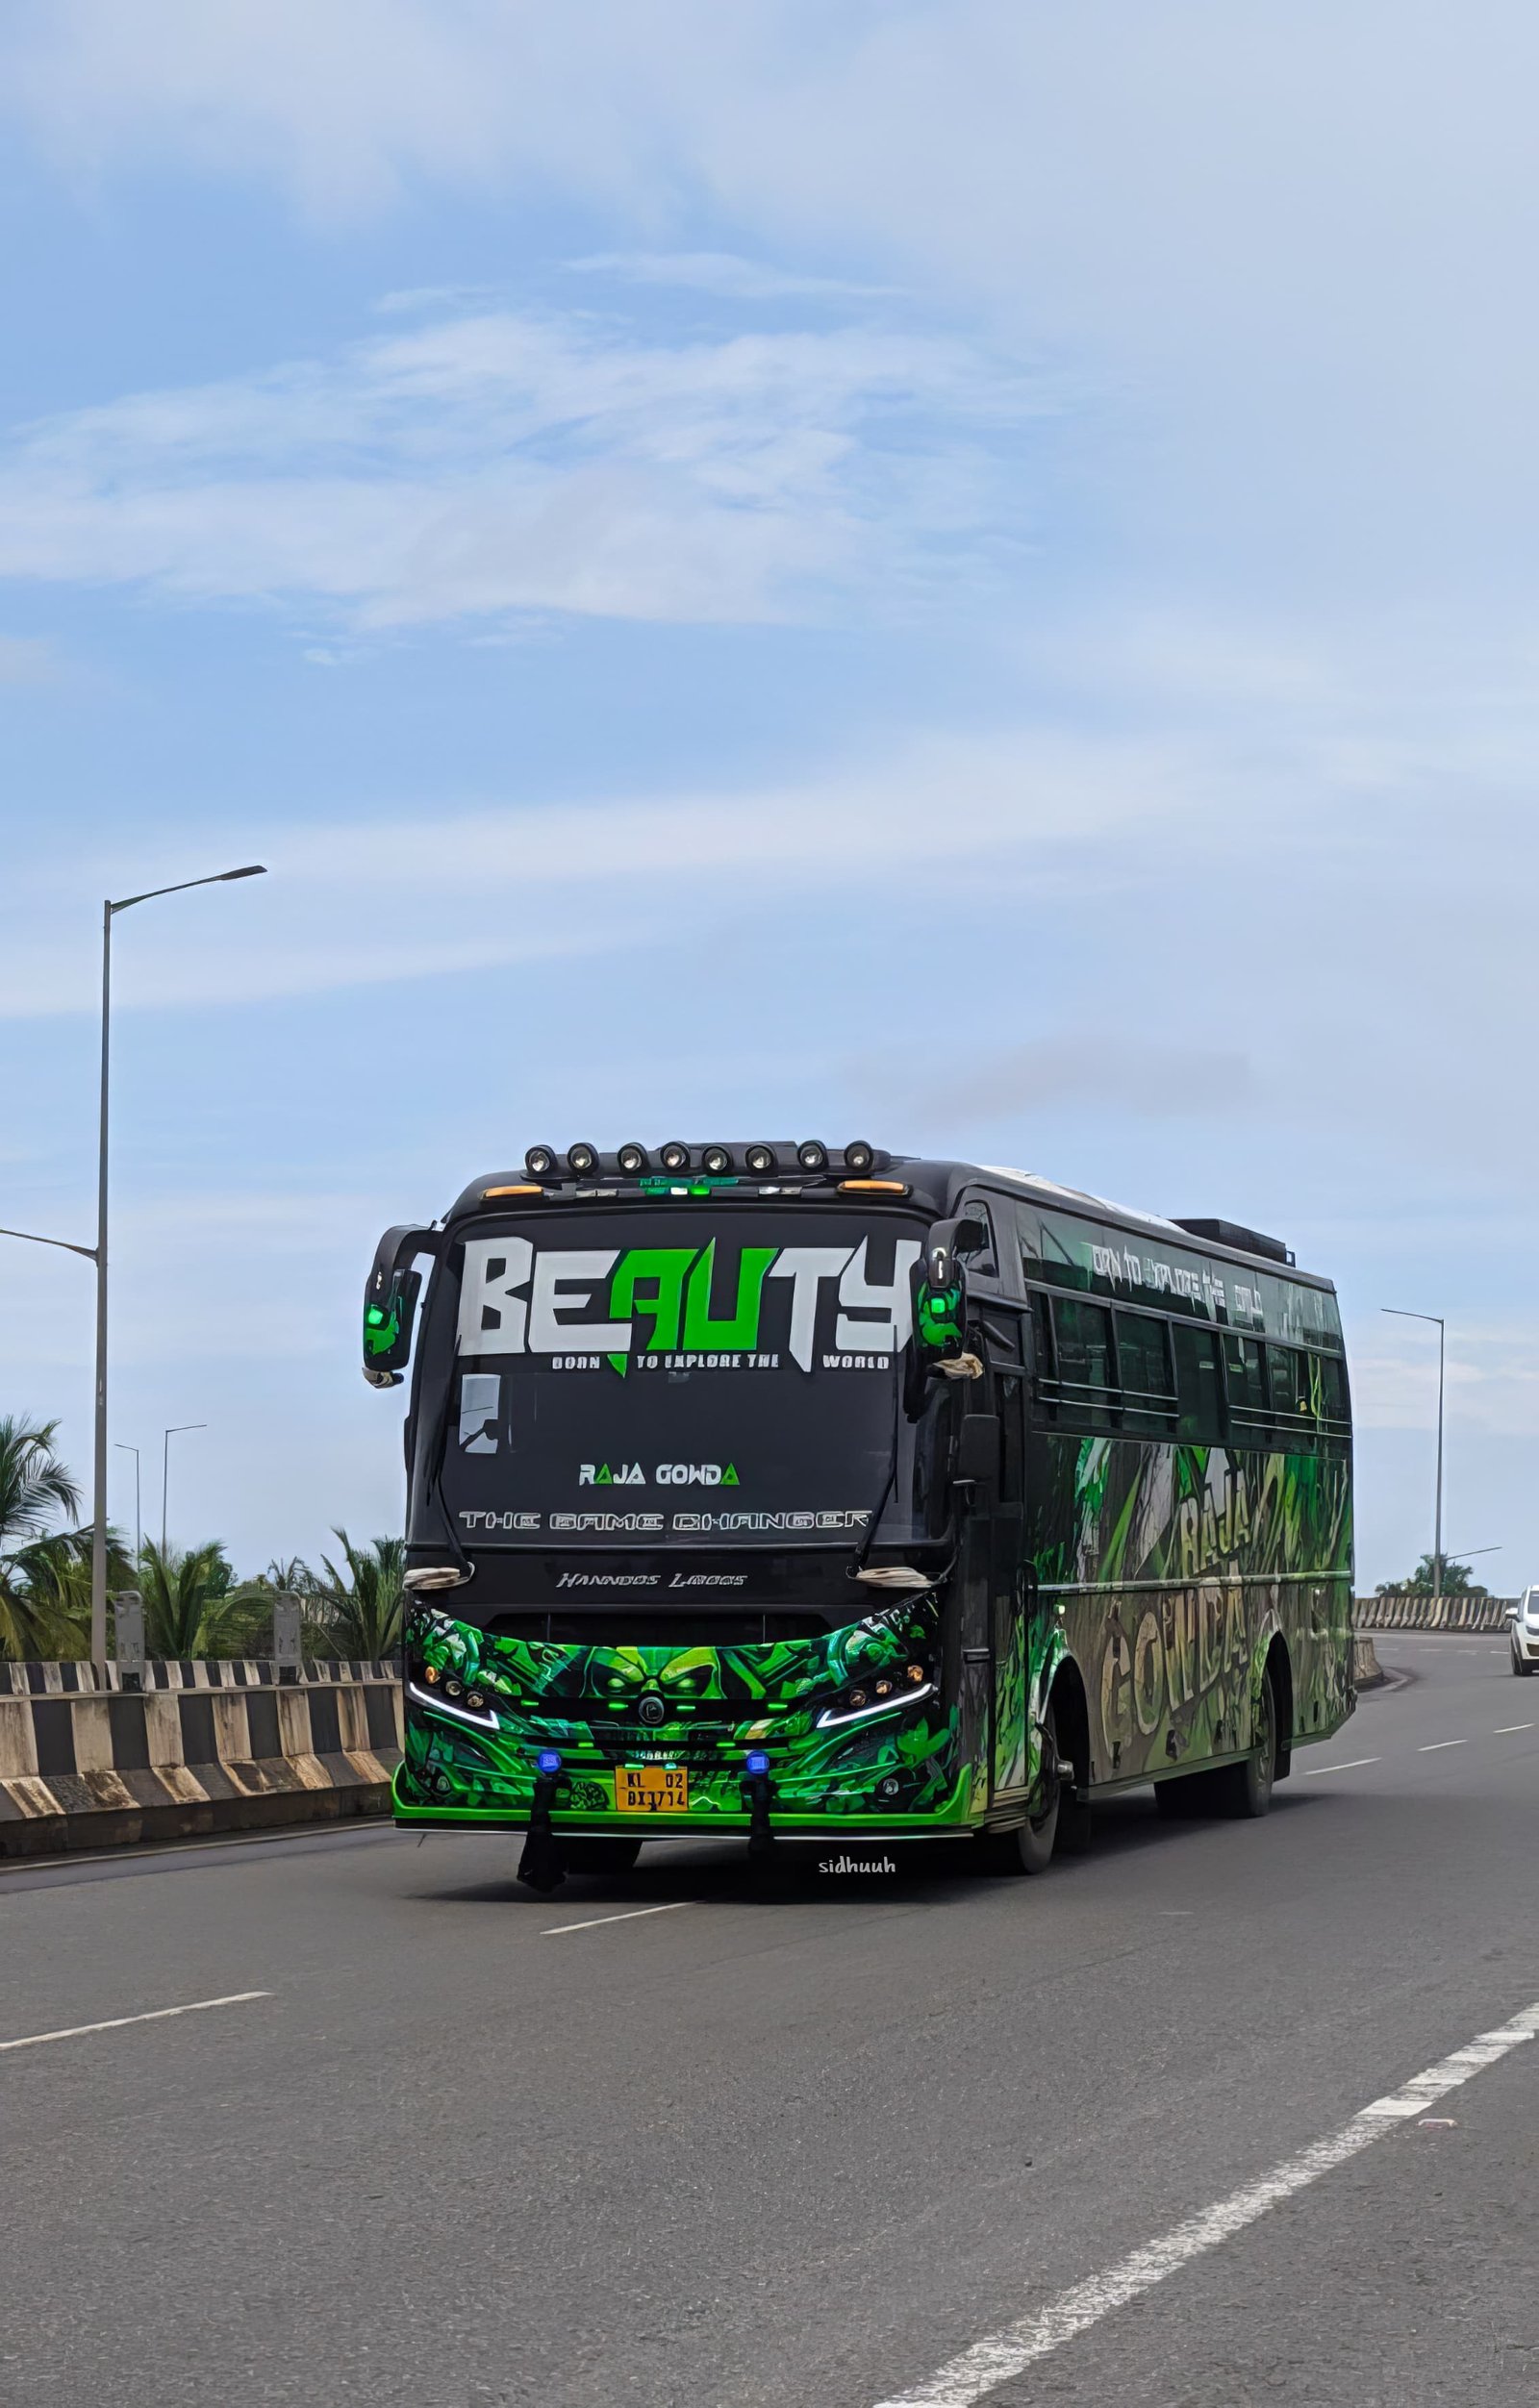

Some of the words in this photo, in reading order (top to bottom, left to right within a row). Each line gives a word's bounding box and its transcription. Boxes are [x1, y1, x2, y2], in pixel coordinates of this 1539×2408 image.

[457, 1236, 922, 1378] BEAUTY
[637, 1355, 658, 1369] TO
[664, 1354, 742, 1368] EXPLORE
[747, 1354, 779, 1367] THE
[822, 1354, 890, 1369] WORLD
[579, 1462, 646, 1486] RAJA
[655, 1462, 741, 1486] GOWDA
[459, 1511, 542, 1529] THE
[549, 1513, 665, 1531] GAME
[672, 1510, 873, 1531] CHANGER
[627, 1772, 646, 1788] KL
[665, 1772, 684, 1789] 02
